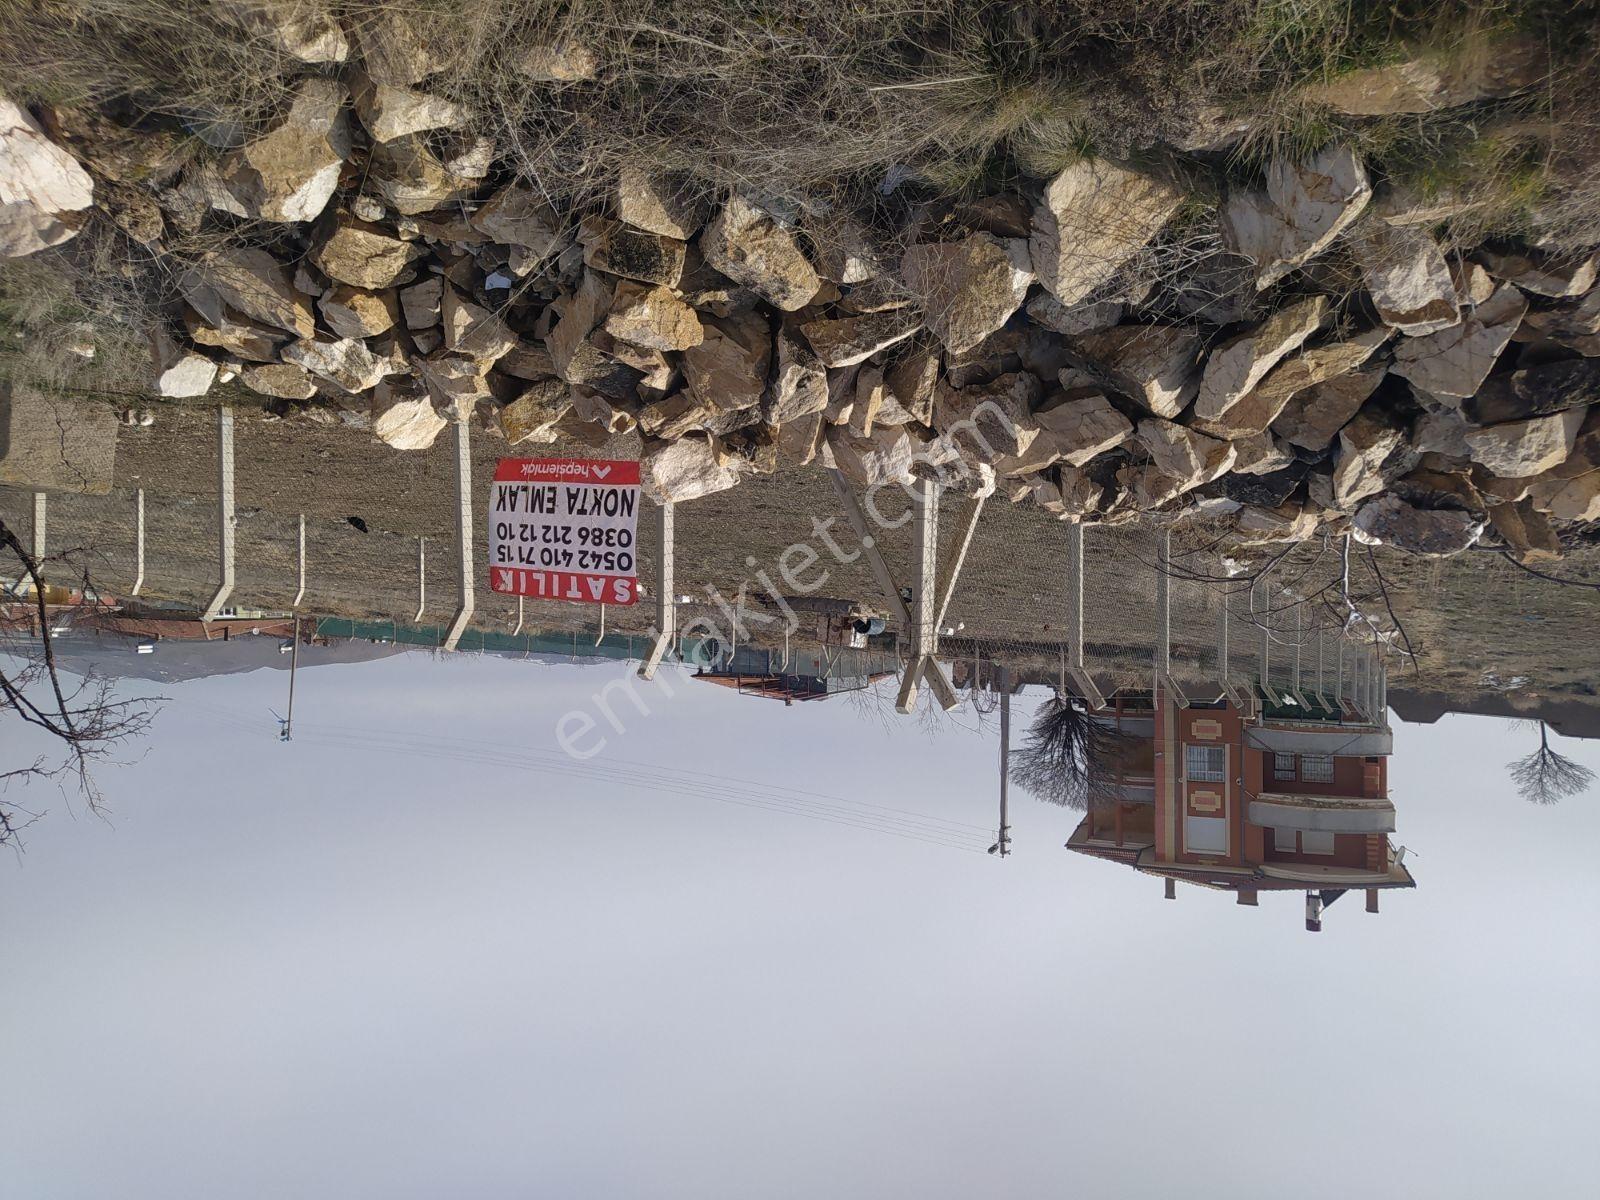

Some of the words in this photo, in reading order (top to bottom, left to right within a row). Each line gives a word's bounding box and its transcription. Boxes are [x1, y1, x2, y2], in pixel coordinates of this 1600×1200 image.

[521, 462, 589, 478] hepsiemlak
[496, 485, 557, 514] EMLAK
[566, 487, 635, 517] NOKTA
[496, 522, 515, 540] 10
[519, 524, 537, 542] 12
[542, 525, 572, 545] 212
[577, 527, 632, 548] 0386
[497, 544, 514, 562] 15
[518, 546, 535, 565] 71
[540, 547, 573, 567] 410
[578, 550, 633, 572] 0542
[498, 570, 631, 603] SATILIK
